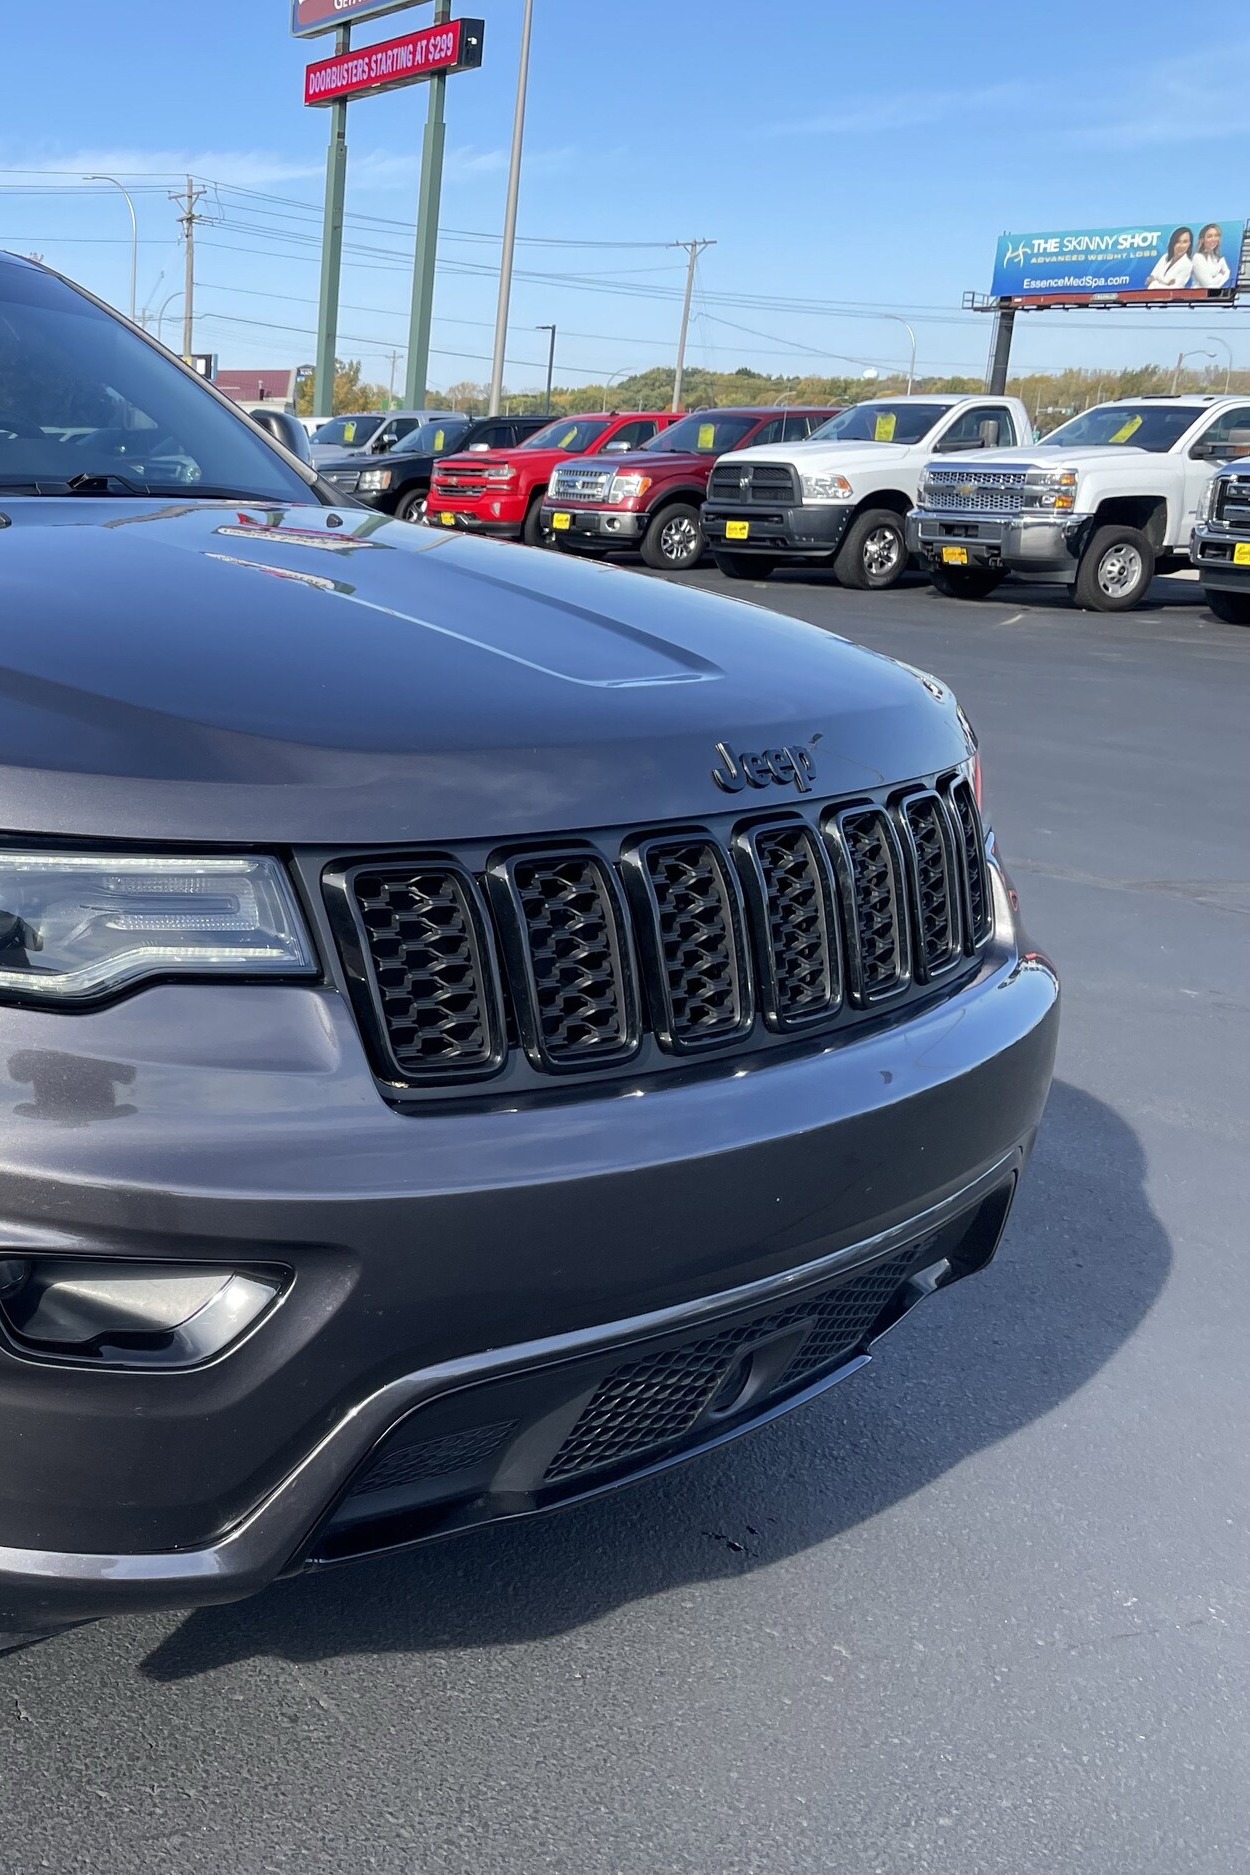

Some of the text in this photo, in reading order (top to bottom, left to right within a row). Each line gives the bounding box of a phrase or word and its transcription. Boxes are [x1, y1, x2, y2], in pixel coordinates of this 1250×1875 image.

[309, 32, 454, 95] DOORBUSTERS STARTING AT $299
[1032, 231, 1161, 254] THE SKINNY SHOT
[1030, 250, 1157, 264] ADVANCED WEIGHT LOSS
[1023, 275, 1130, 289] EssenceMedSpa.com
[711, 741, 817, 794] Jeep
